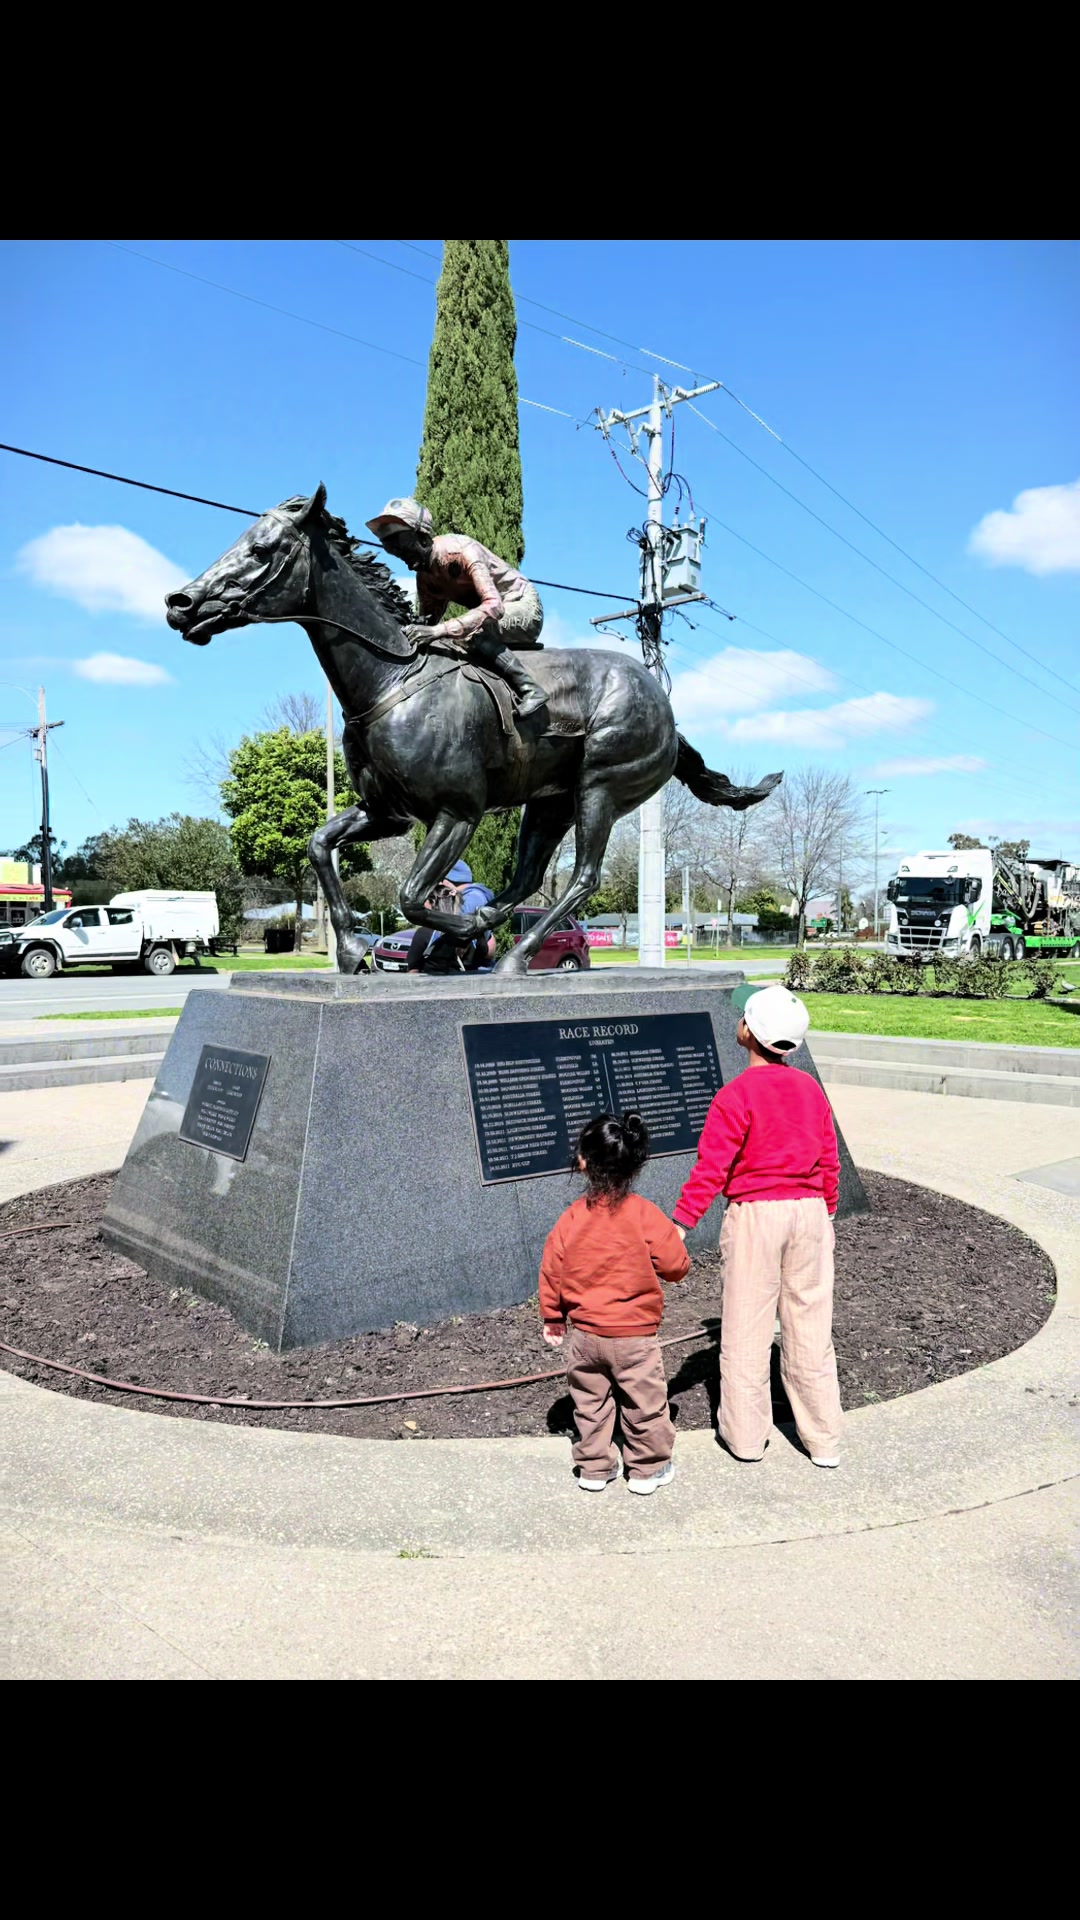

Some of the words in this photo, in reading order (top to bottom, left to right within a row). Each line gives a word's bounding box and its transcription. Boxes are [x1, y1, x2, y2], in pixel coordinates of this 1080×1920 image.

[558, 1027, 590, 1039] RACE
[592, 1023, 639, 1038] RECORD
[205, 1057, 258, 1080] CONNECTIONS
